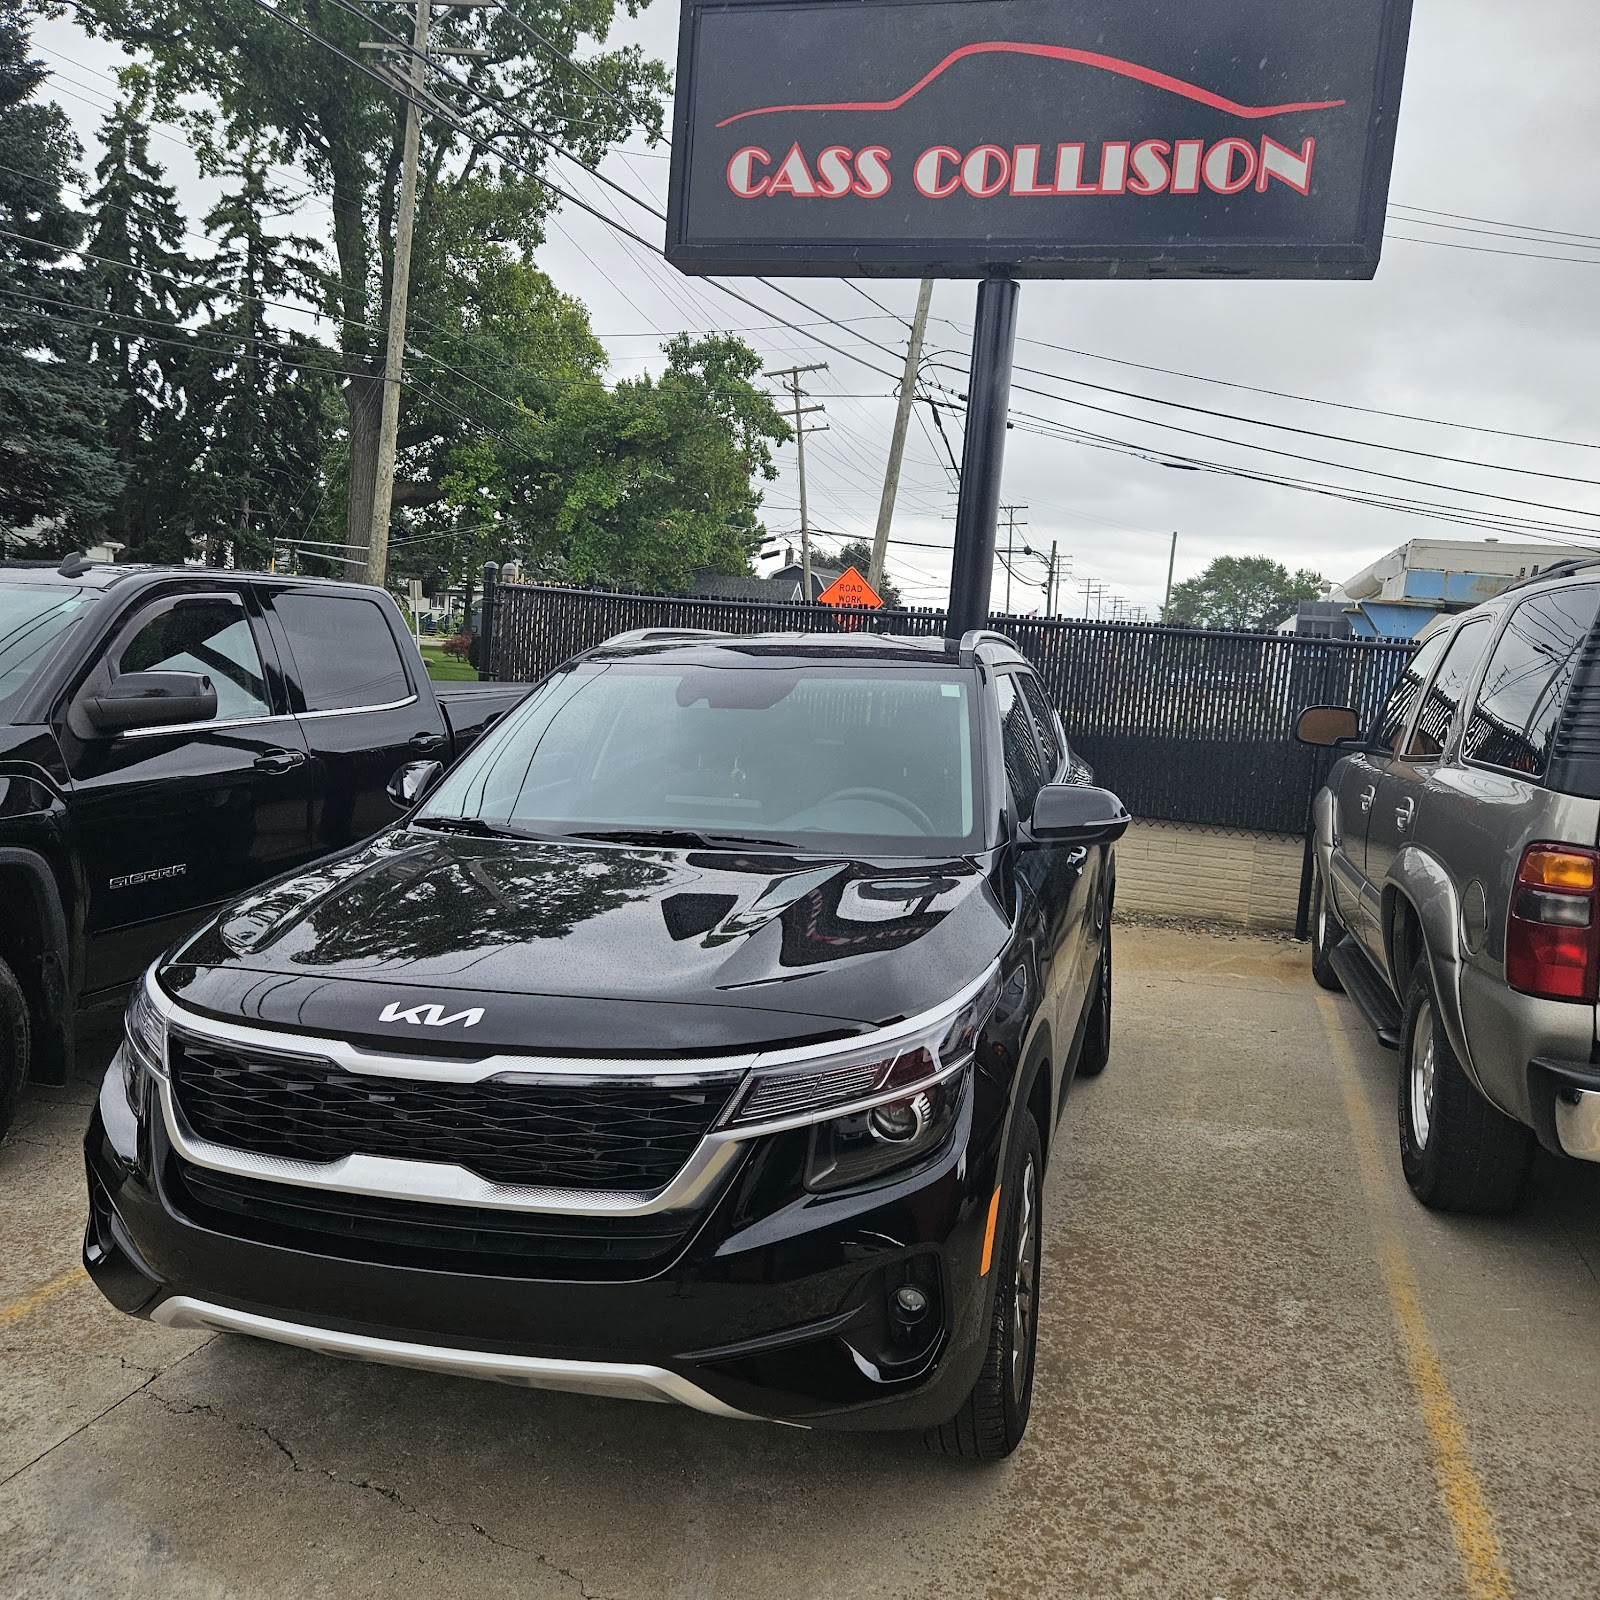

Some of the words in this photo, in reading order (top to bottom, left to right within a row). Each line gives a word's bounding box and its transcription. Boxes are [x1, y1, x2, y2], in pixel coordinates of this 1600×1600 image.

[727, 141, 892, 198] CASS
[913, 134, 1315, 199] COLLISION
[838, 595, 862, 604] WORK
[839, 583, 863, 593] ROAD
[109, 863, 187, 890] SIERRA
[378, 1001, 486, 1029] KIA
